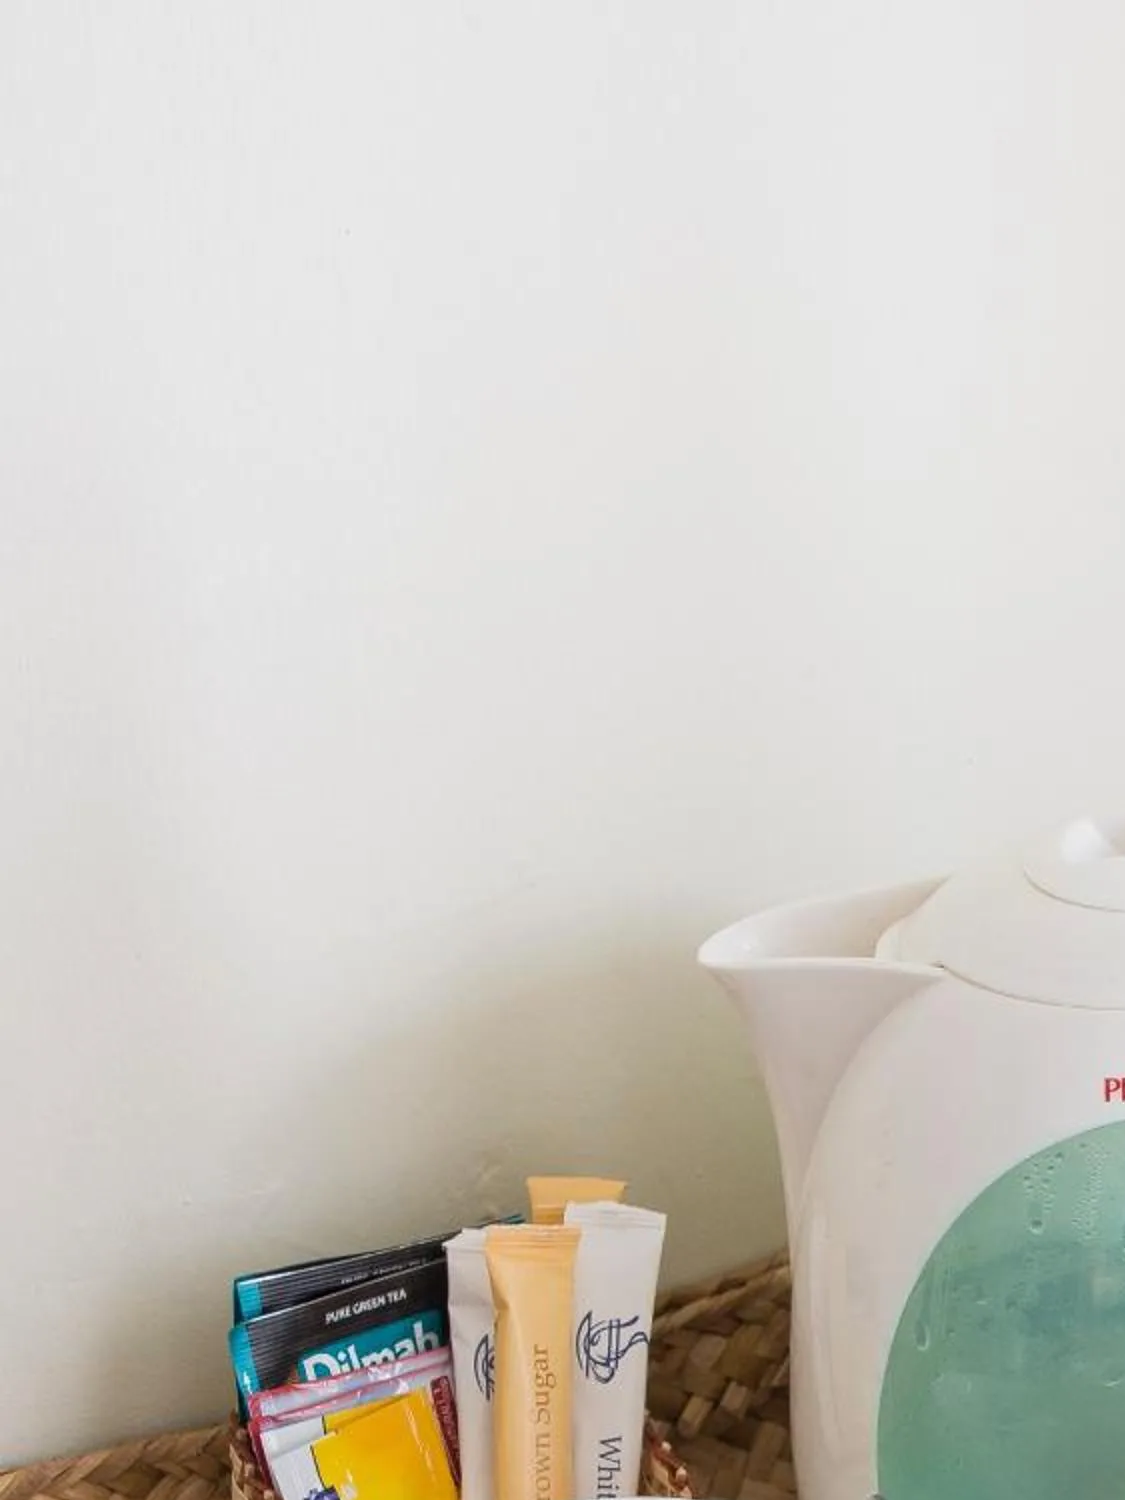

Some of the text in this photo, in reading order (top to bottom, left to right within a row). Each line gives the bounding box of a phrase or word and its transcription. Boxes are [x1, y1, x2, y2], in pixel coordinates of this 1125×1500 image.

[324, 1287, 408, 1325] PURE GREEN TEA
[533, 1343, 557, 1425] Sugar
[596, 1435, 623, 1500] Whit
